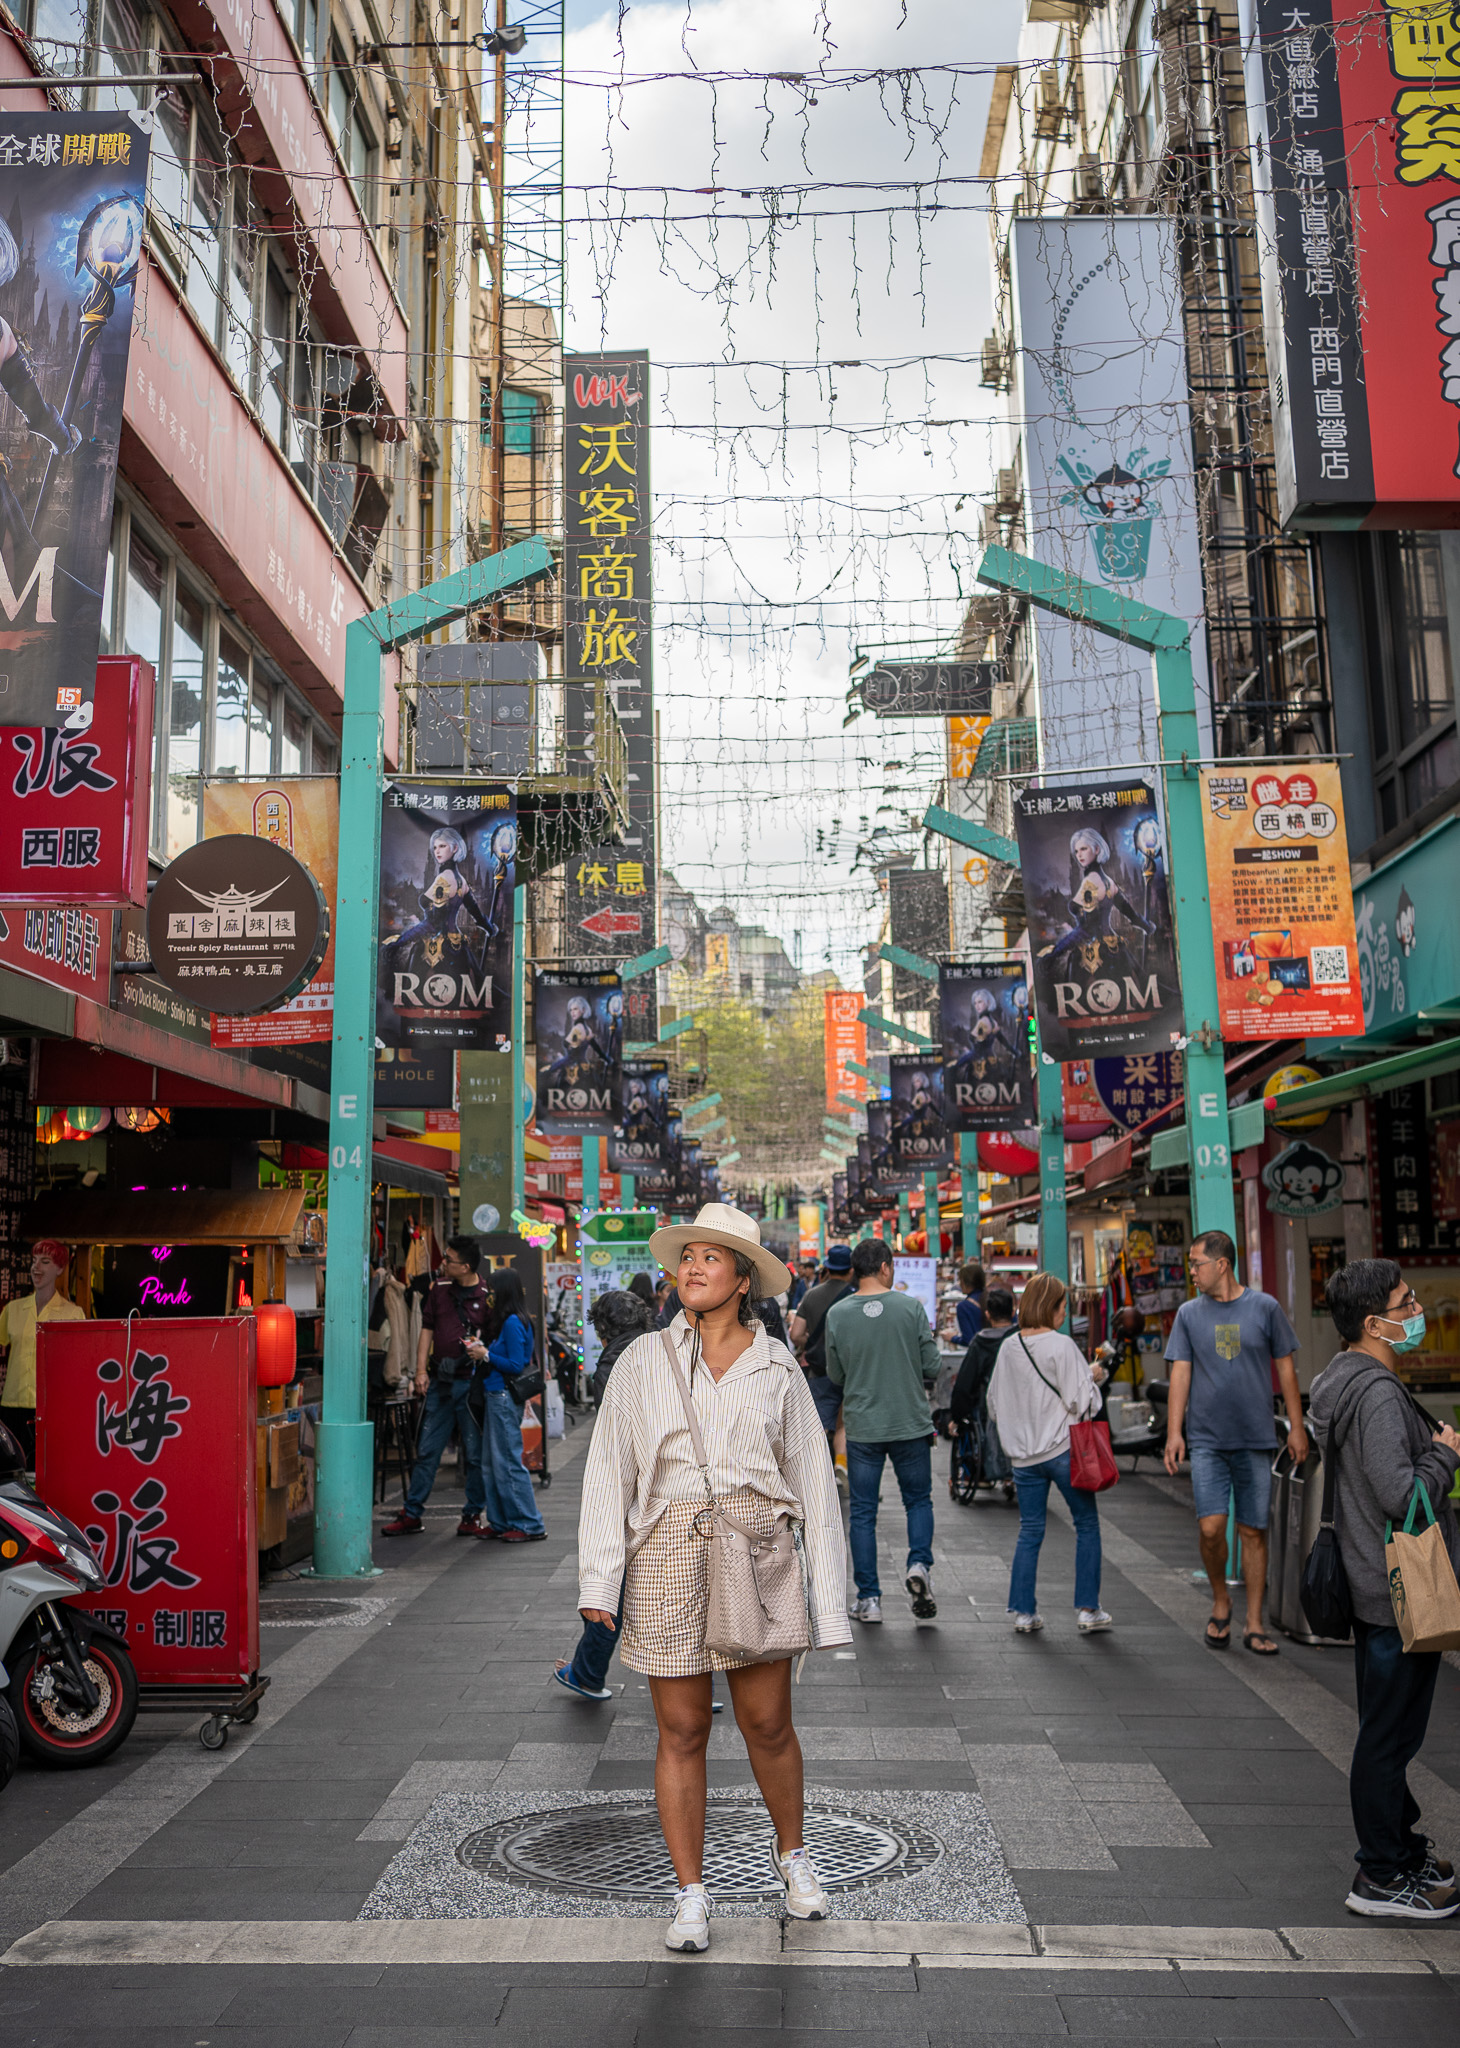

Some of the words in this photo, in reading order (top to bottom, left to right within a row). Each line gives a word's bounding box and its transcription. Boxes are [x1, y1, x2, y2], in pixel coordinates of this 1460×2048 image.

[0, 133, 132, 167] 全球開戰
[578, 421, 638, 668] 沃客商旅
[21, 827, 101, 870] 西服
[576, 861, 647, 897] 休息
[168, 944, 197, 953] Treesir
[198, 943, 221, 953] Spicy
[223, 943, 268, 952] Restaurant
[123, 980, 138, 1007] Spicy
[139, 986, 152, 1009] Duck
[152, 993, 168, 1016] Blood
[393, 972, 494, 1009] ROM
[1053, 974, 1163, 1019] ROM
[395, 1070, 435, 1081] HOLE
[547, 1088, 612, 1111] ROM
[955, 1082, 1022, 1106] ROM
[1199, 1093, 1219, 1117] E
[338, 1095, 358, 1119] E
[332, 1146, 363, 1169] 04
[614, 1142, 660, 1159] ROM
[899, 1138, 946, 1154] ROM
[1197, 1144, 1228, 1167] 03
[1047, 1156, 1059, 1171] E
[967, 1191, 976, 1203] E
[1045, 1188, 1064, 1201] 05
[965, 1213, 979, 1224] 07
[518, 1221, 556, 1240] Beer
[139, 1276, 192, 1305] Pink
